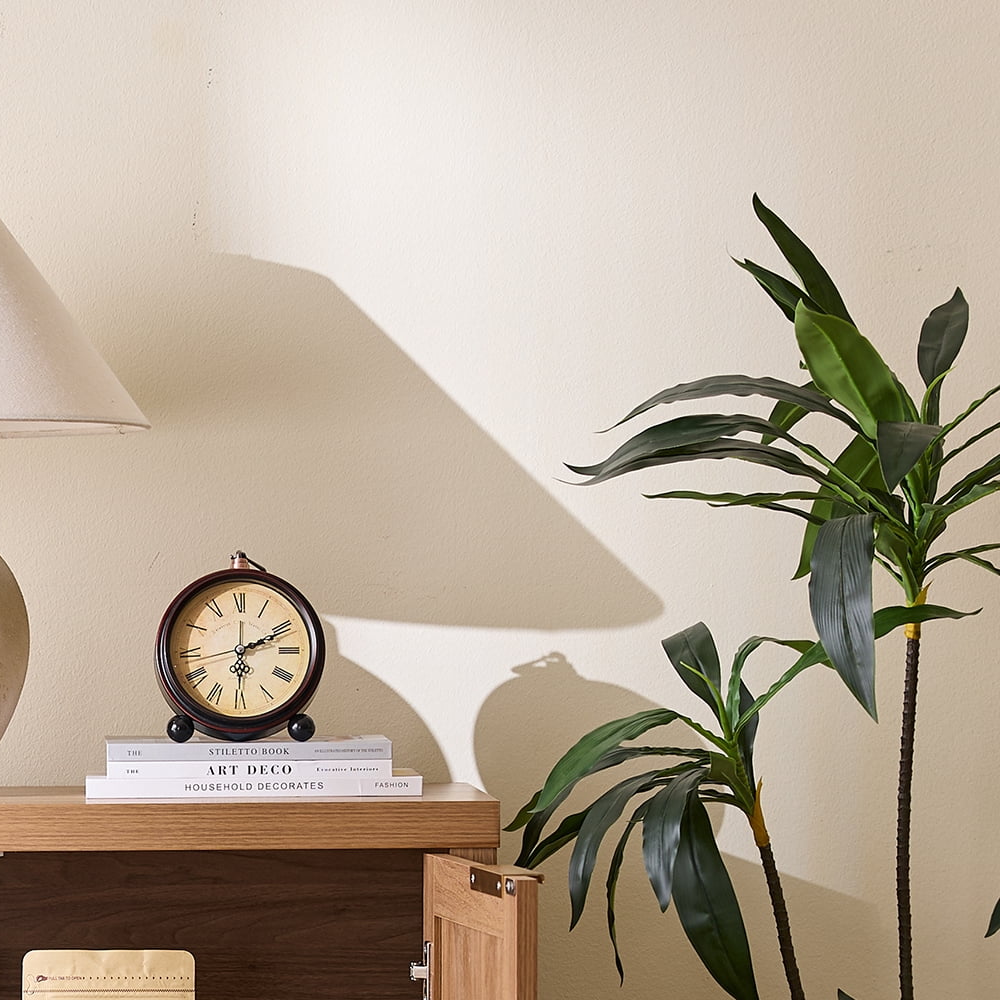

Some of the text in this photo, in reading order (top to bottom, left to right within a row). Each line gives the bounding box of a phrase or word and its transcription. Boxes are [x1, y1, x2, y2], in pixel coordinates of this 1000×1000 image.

[208, 747, 258, 756] STILETTO
[262, 747, 290, 755] BOOK
[206, 765, 239, 776] ART
[247, 764, 293, 775] DECO
[184, 782, 253, 792] HOUSEHOLD
[257, 781, 325, 791] DECORATES
